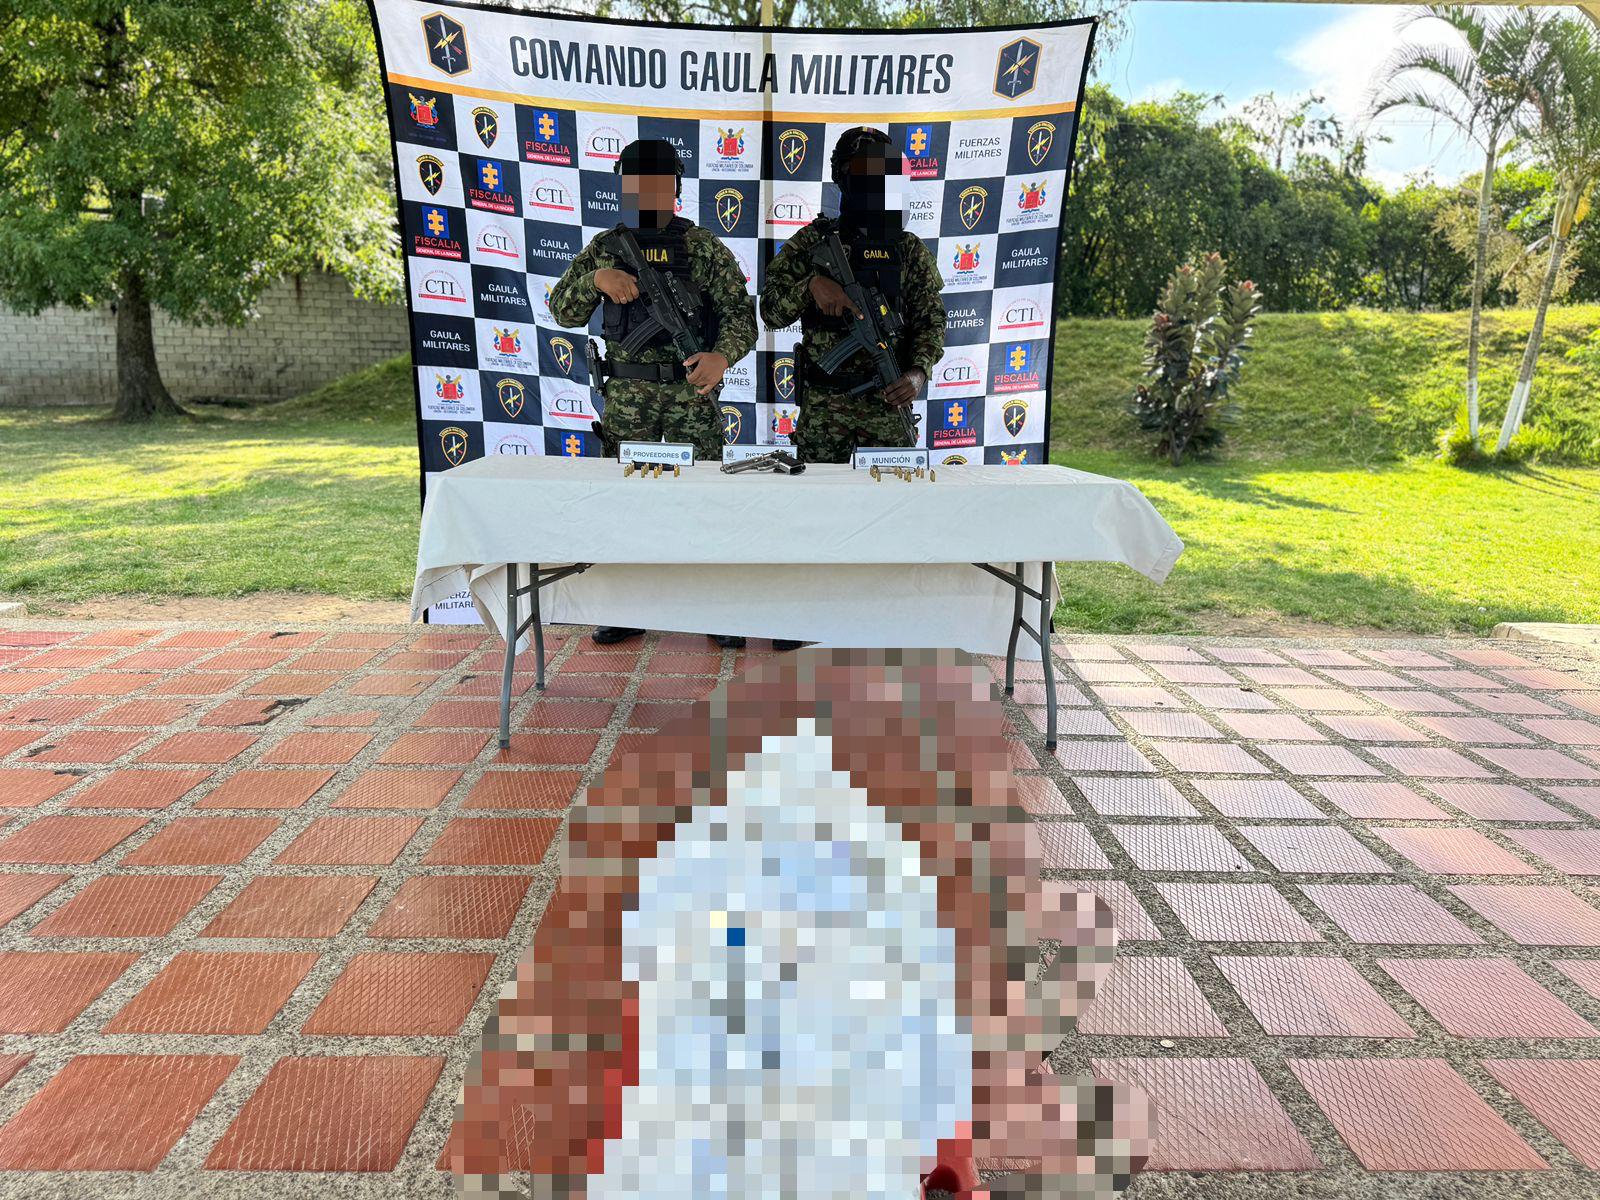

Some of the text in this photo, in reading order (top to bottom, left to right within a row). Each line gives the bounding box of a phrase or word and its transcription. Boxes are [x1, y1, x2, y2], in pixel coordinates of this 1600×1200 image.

[509, 35, 954, 96] COMANDO GAULA MILITARES
[525, 141, 570, 155] FISCALIA
[592, 136, 621, 153] CTI
[959, 137, 1001, 148] FUERZAS
[955, 148, 1002, 160] MILITARES
[910, 158, 939, 168] CALIA
[469, 189, 515, 204] FISCALIA
[536, 186, 564, 204] CTI
[595, 190, 619, 201] GAUL
[587, 200, 619, 212] MILITA
[773, 204, 802, 219] CTI
[910, 200, 933, 210] RZAS
[415, 235, 461, 250] FISCALIA
[483, 233, 508, 250] CTI
[540, 239, 570, 250] GAULA
[863, 249, 890, 259] GAULA
[1011, 247, 1041, 258] GAULA
[1002, 257, 1049, 270] MILITARES
[425, 278, 455, 296] CTI
[488, 283, 519, 295] GAULA
[480, 293, 527, 306] MILITARES
[947, 308, 977, 318] GAULA
[1005, 307, 1035, 323] CTI
[946, 318, 985, 329] ILITARES
[430, 330, 461, 340] GAULA
[422, 339, 471, 352] MILITARES
[943, 366, 971, 381] CTI
[994, 371, 1039, 384] FISCALIA
[555, 398, 584, 414] CTI
[933, 427, 977, 439] FISCALIA
[499, 443, 528, 456] CTI
[633, 451, 680, 459] PROVEEDORES
[871, 455, 911, 464] MUNICIÓN
